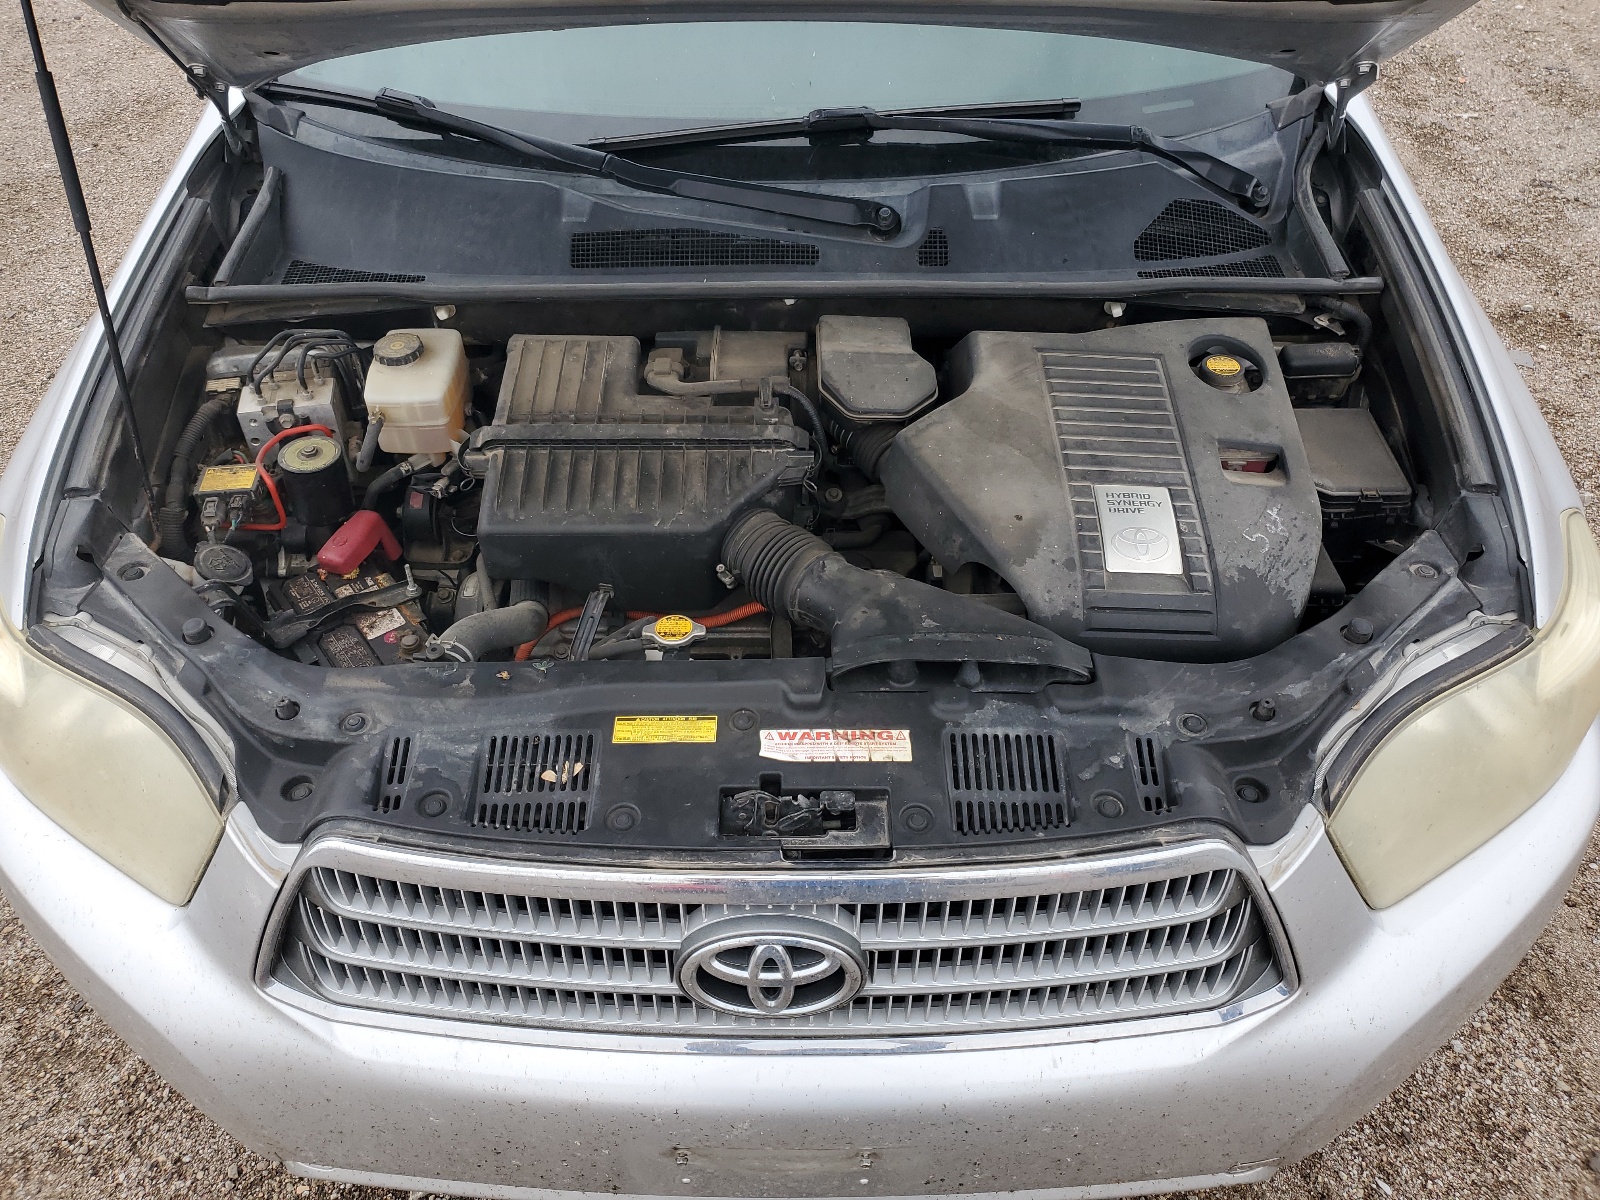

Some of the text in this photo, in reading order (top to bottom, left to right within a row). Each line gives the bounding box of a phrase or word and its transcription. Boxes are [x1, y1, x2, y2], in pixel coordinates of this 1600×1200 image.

[1105, 492, 1151, 500] HYBRID
[1106, 499, 1163, 508] SYNERGY
[777, 731, 893, 740] WARNING
